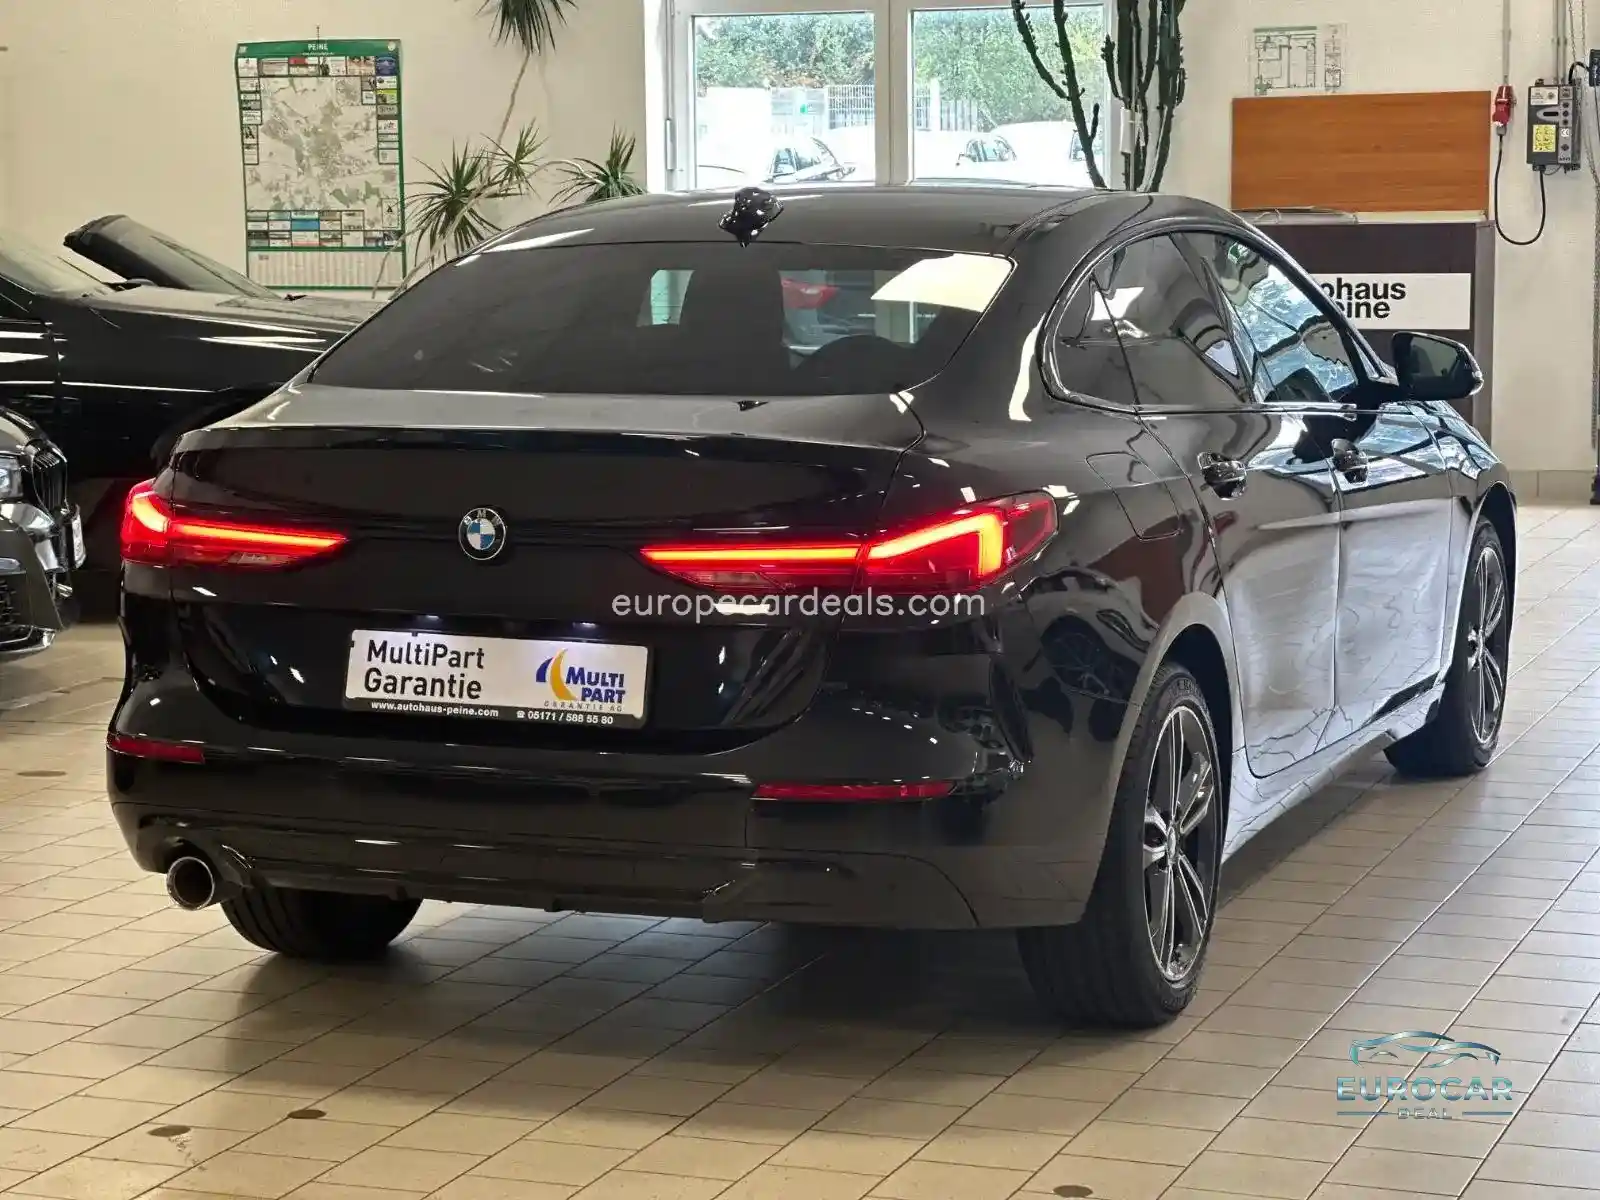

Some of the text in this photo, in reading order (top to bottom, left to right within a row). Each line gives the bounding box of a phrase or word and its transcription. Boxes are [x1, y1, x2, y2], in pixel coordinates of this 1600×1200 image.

[307, 43, 329, 51] PEINE
[367, 639, 485, 669] MultiPart
[364, 667, 482, 699] Garantie
[565, 666, 625, 688] MULTI
[581, 687, 626, 704] PART
[371, 700, 499, 717] www.autohaus-peine.com
[527, 710, 556, 721] 05171
[586, 715, 598, 724] 55
